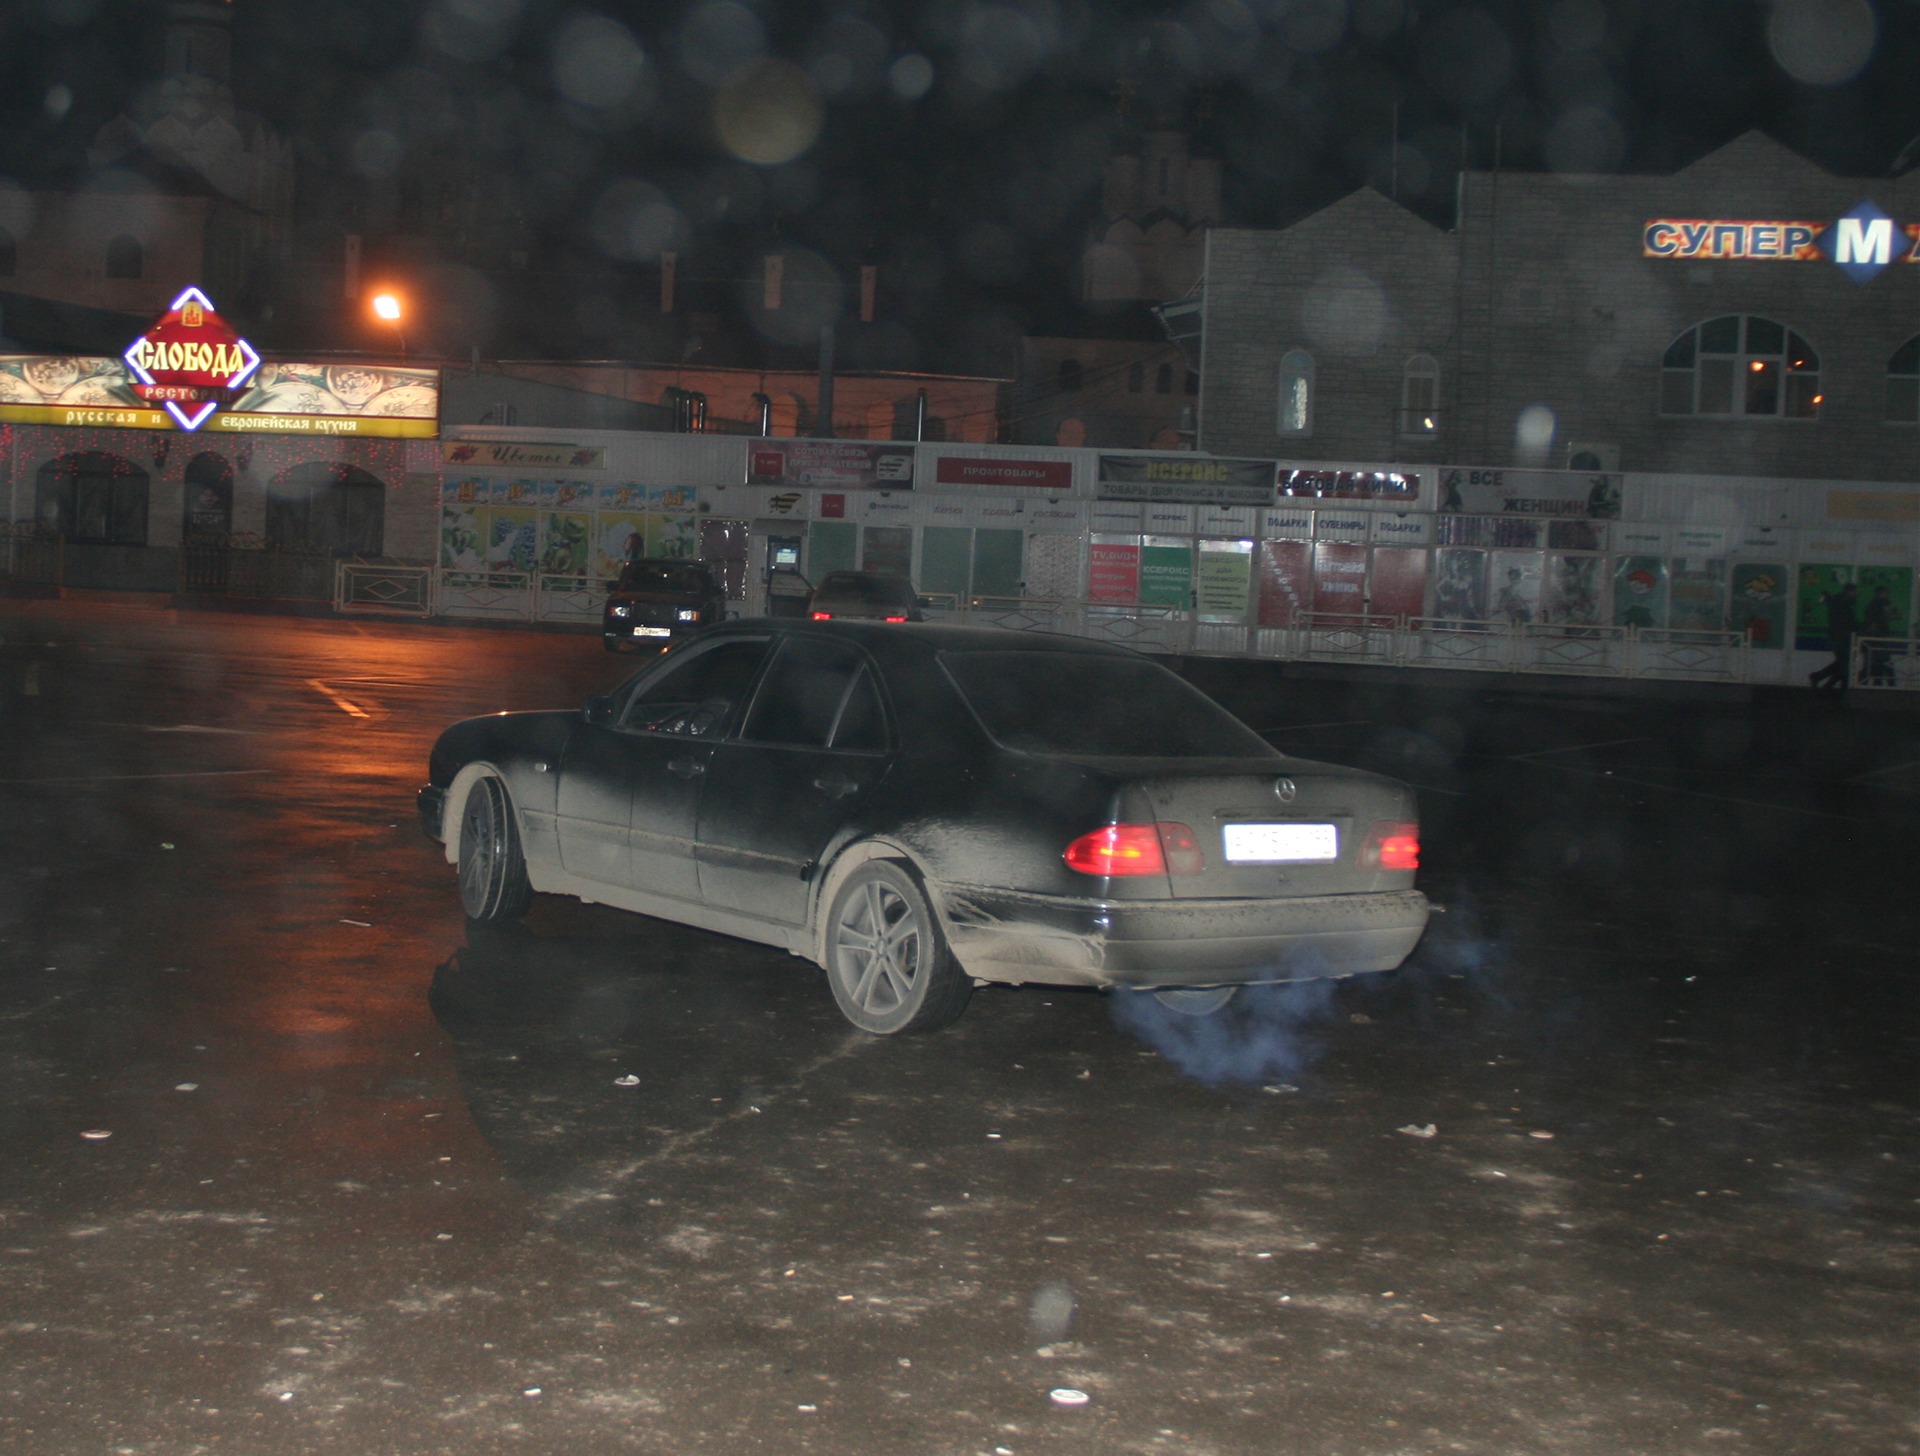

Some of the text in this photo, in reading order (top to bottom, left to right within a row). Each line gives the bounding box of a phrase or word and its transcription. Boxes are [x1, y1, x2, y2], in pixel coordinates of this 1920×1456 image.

[1644, 222, 1815, 258] СУПЕР
[136, 339, 245, 379] СЛОБОДА
[144, 386, 231, 402] РЕСТОРАН
[487, 445, 561, 466] Цветы
[963, 466, 1046, 478] ПРОМТОВАРЫ
[1146, 462, 1228, 481] КСЕРОКС
[1469, 471, 1504, 487] ВСЕ
[1104, 484, 1148, 495] ТОВАРЫ
[1150, 486, 1173, 497] ДЛЯ
[1227, 488, 1270, 500] ШКОЛЫ
[1502, 499, 1586, 517] ЖЕНЩИН
[1267, 518, 1308, 528] ПОДАРКИ
[1319, 520, 1366, 530] СУВЕНИРЫ
[1380, 522, 1420, 532] ПОДАРКИ
[1143, 565, 1190, 575] КСЕРОКС
